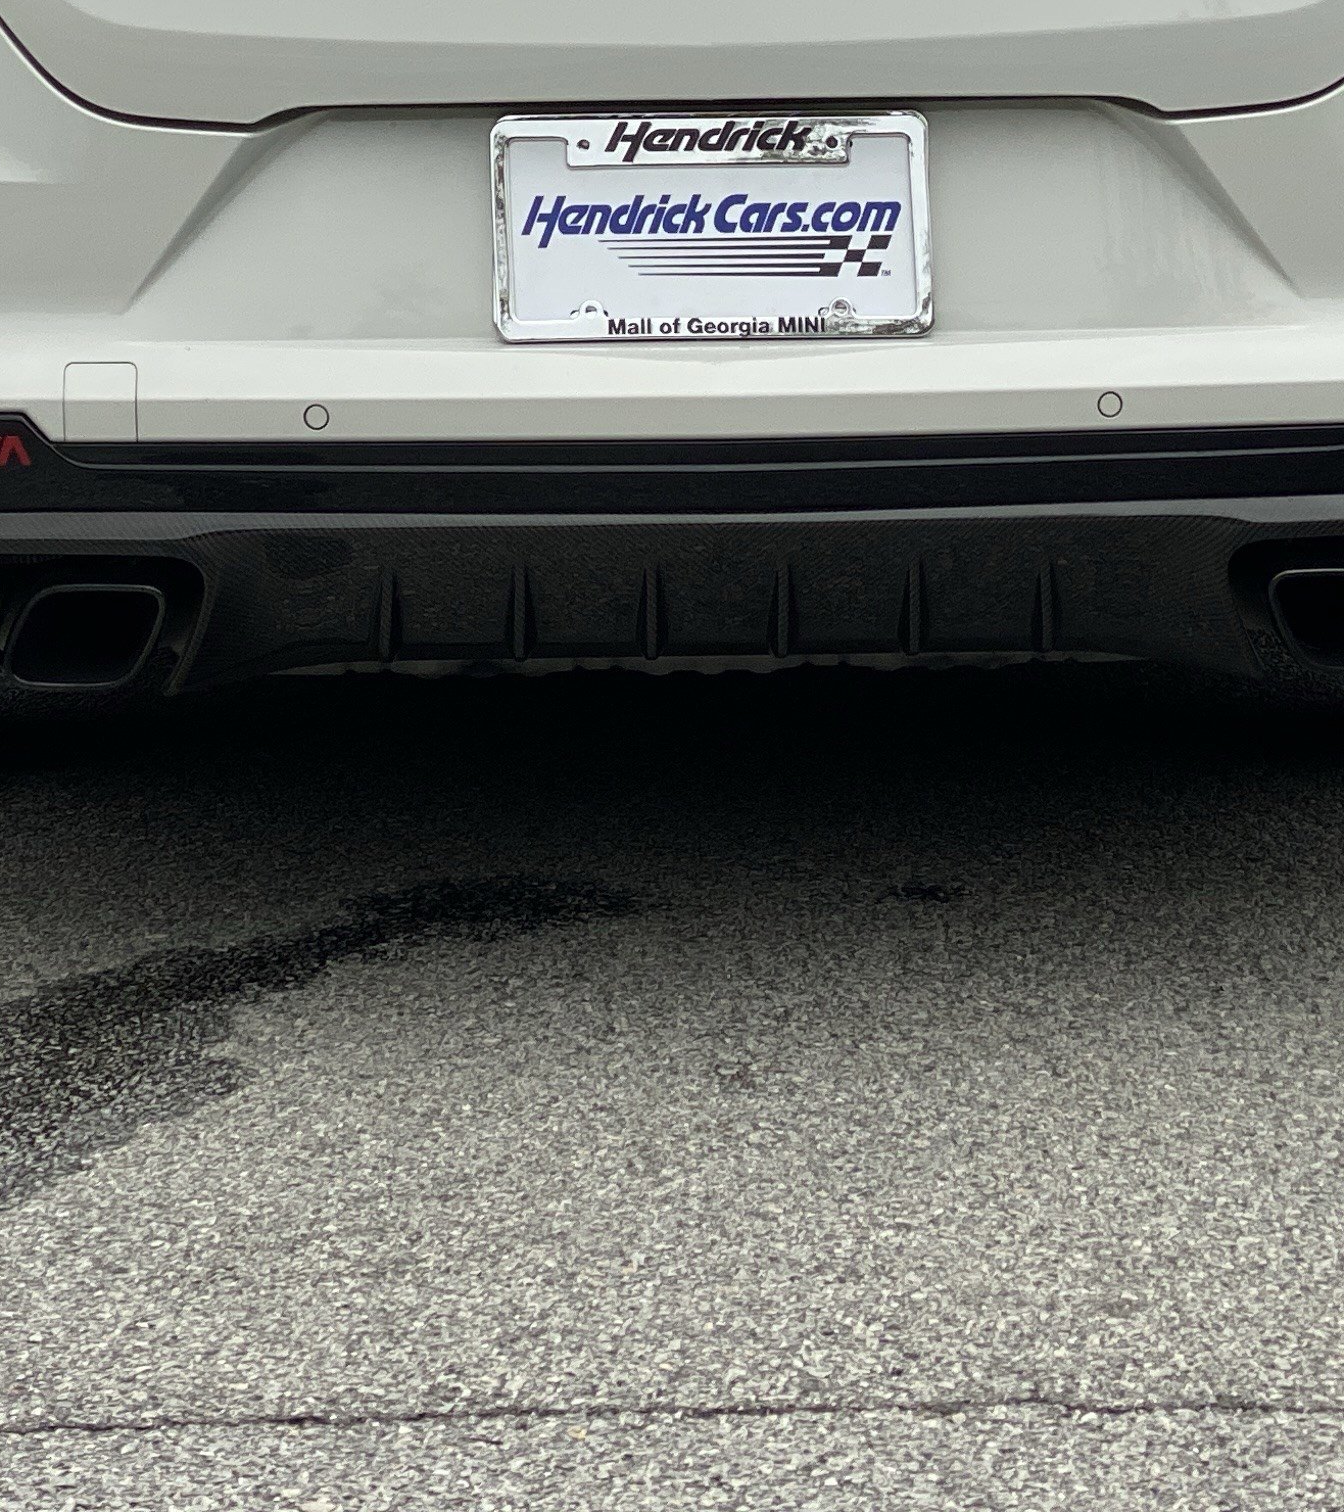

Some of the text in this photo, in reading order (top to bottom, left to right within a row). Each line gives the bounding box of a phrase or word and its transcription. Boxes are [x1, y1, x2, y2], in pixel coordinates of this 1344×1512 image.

[605, 121, 810, 162] Hendrick
[607, 316, 826, 336] Mall of Georgia MINI
